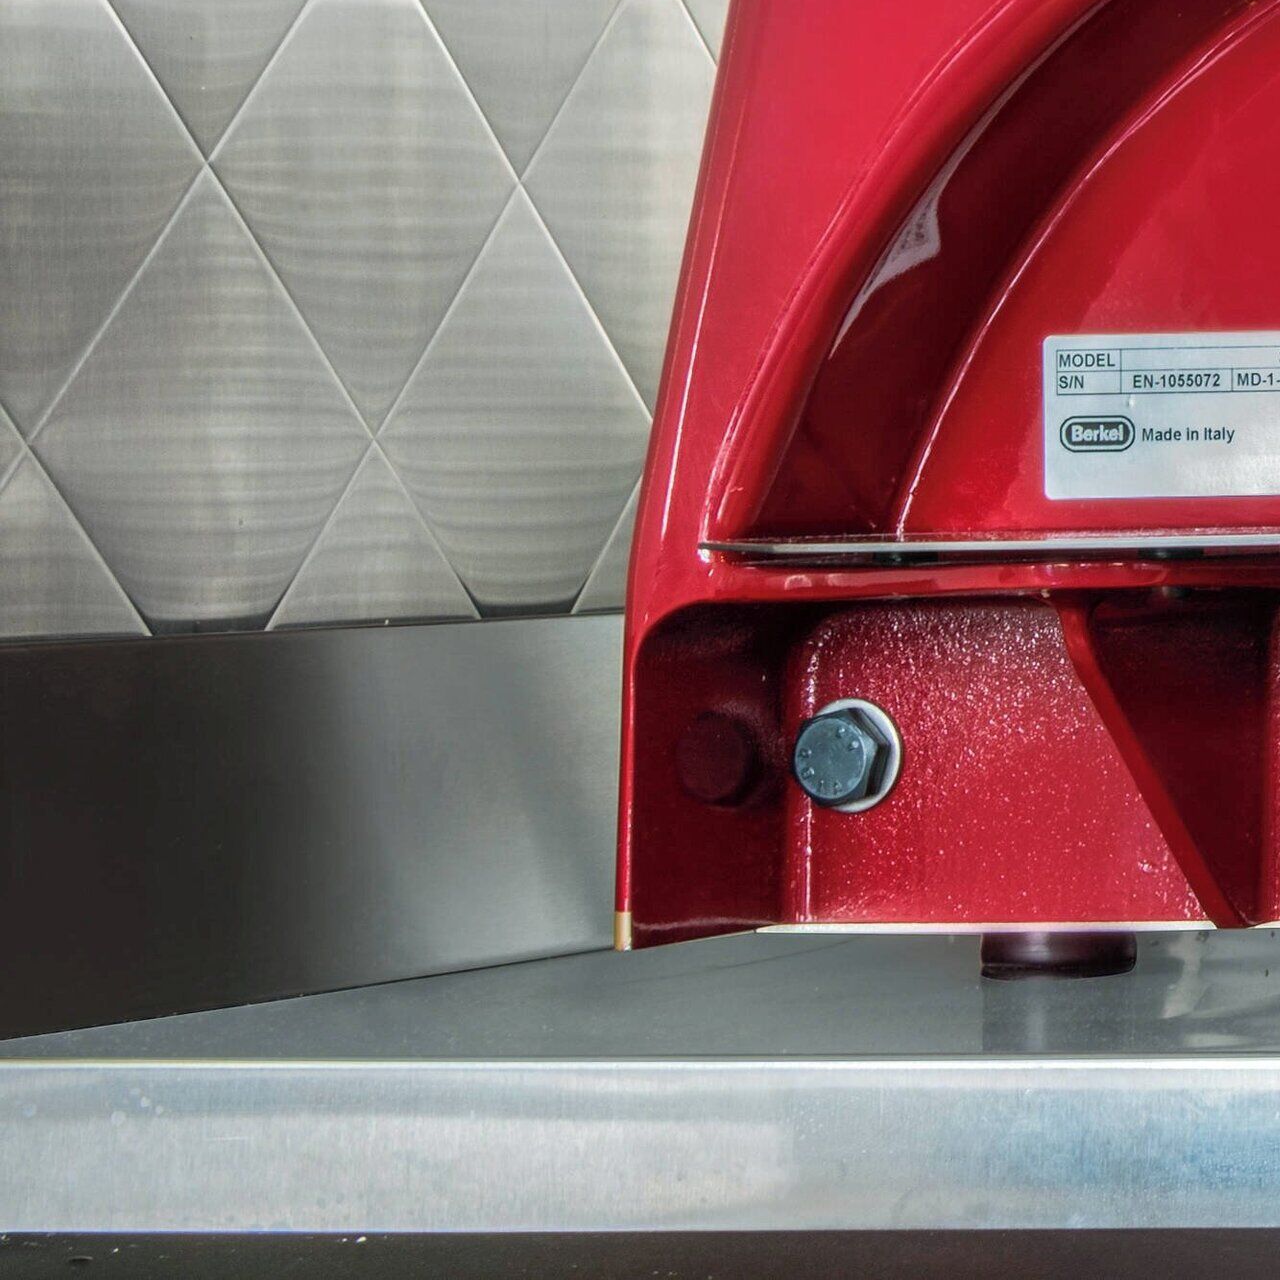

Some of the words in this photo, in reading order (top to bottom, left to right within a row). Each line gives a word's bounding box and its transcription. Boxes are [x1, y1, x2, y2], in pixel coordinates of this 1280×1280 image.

[1058, 353, 1116, 368] MODEL
[1058, 375, 1085, 389] S/N
[1132, 373, 1221, 388] EN-1055072
[1070, 424, 1125, 442] Berkel
[1141, 428, 1182, 441] Made
[1187, 427, 1200, 441] in
[1204, 426, 1236, 444] Italy
